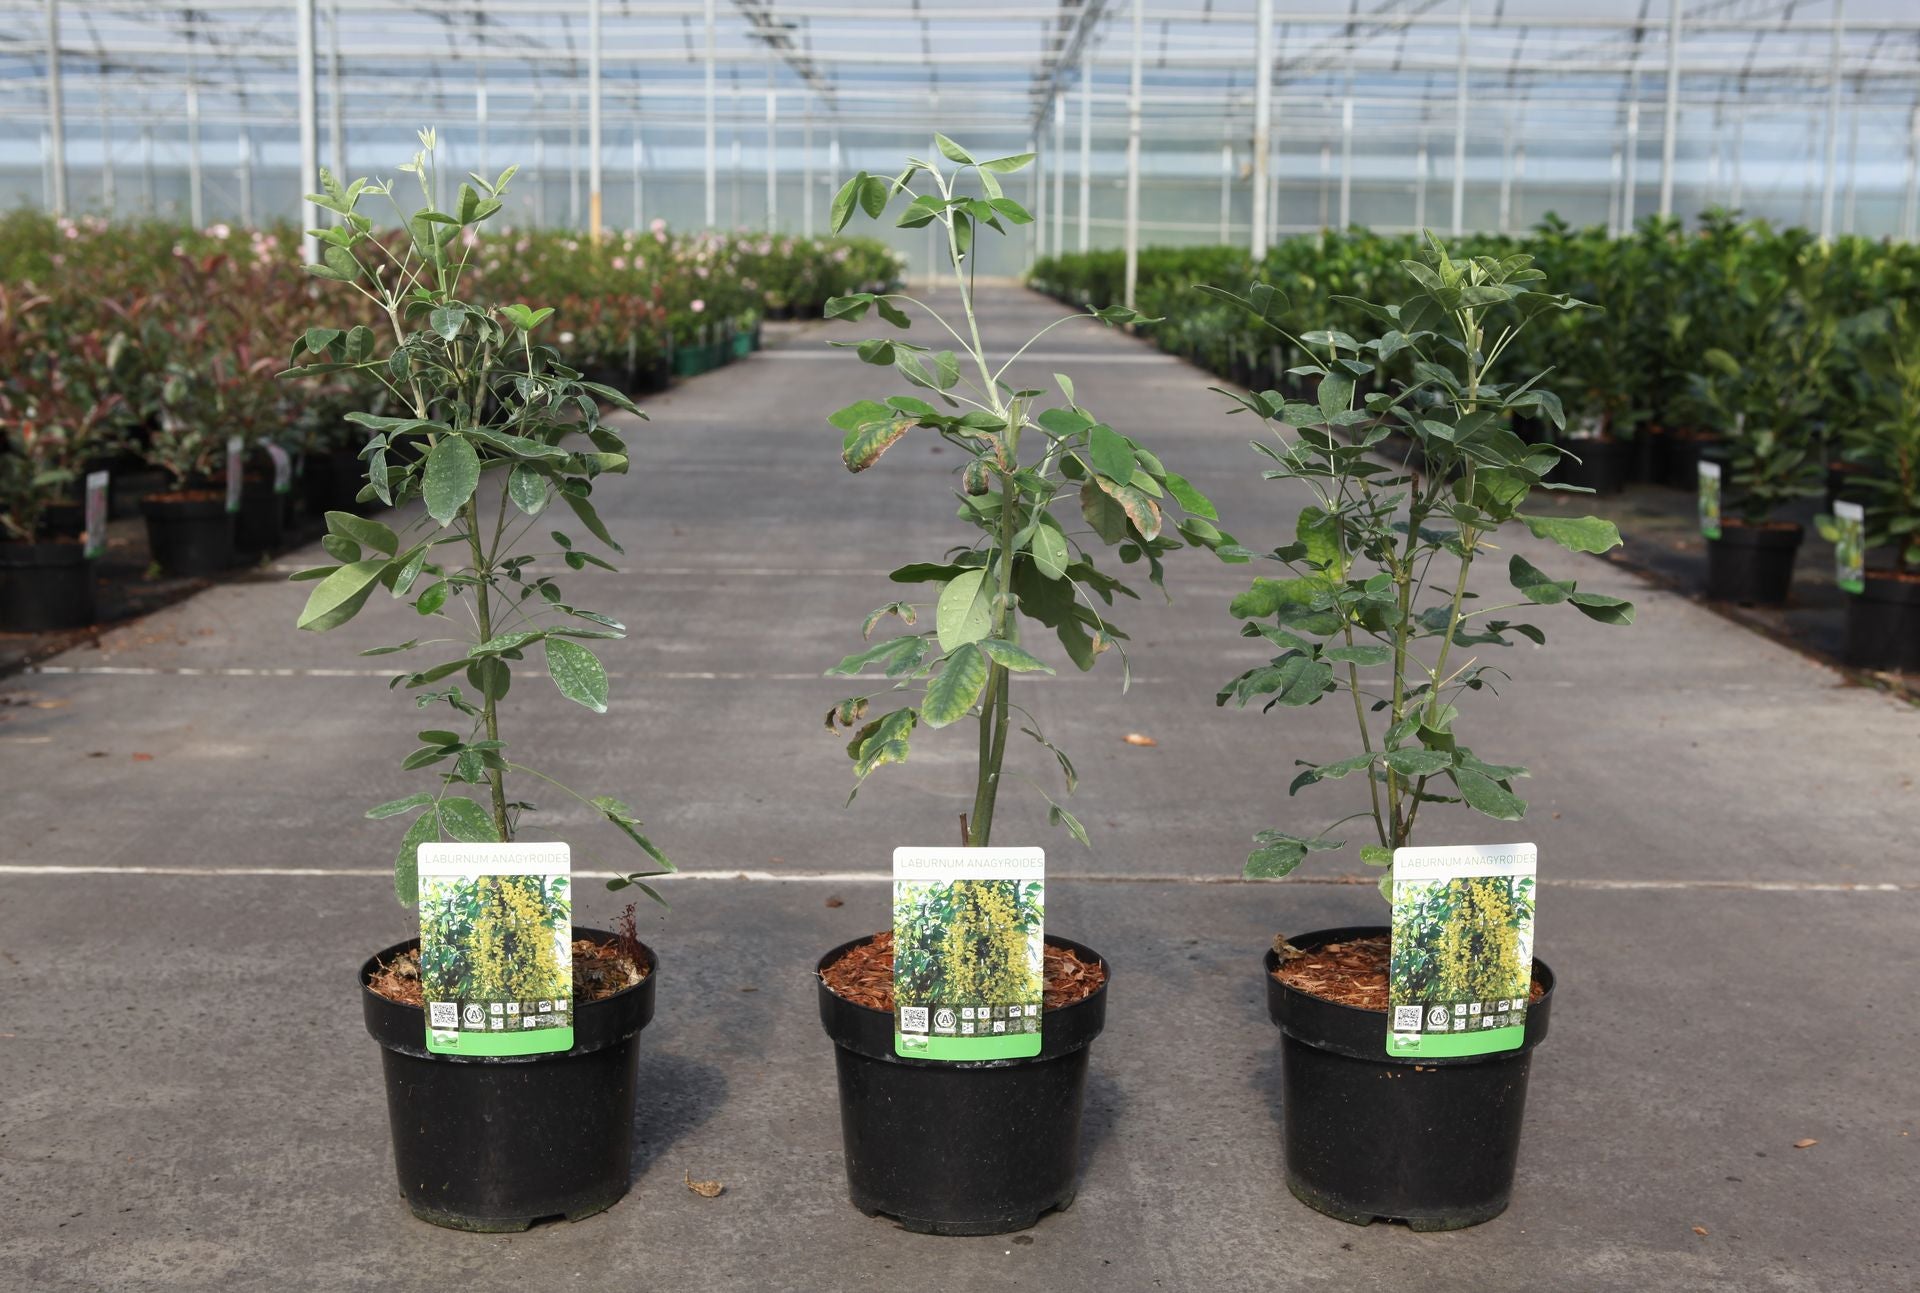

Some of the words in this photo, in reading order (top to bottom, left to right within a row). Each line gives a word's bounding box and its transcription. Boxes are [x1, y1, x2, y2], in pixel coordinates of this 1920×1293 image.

[425, 854, 489, 864] LABURNUM
[492, 853, 569, 863] ANAGYROIDES
[901, 858, 964, 868] LABURNUM
[967, 858, 1044, 868] ANAGYROIDES
[1401, 856, 1461, 868] LABURNUM
[1464, 854, 1536, 865] ANAGYROIDES
